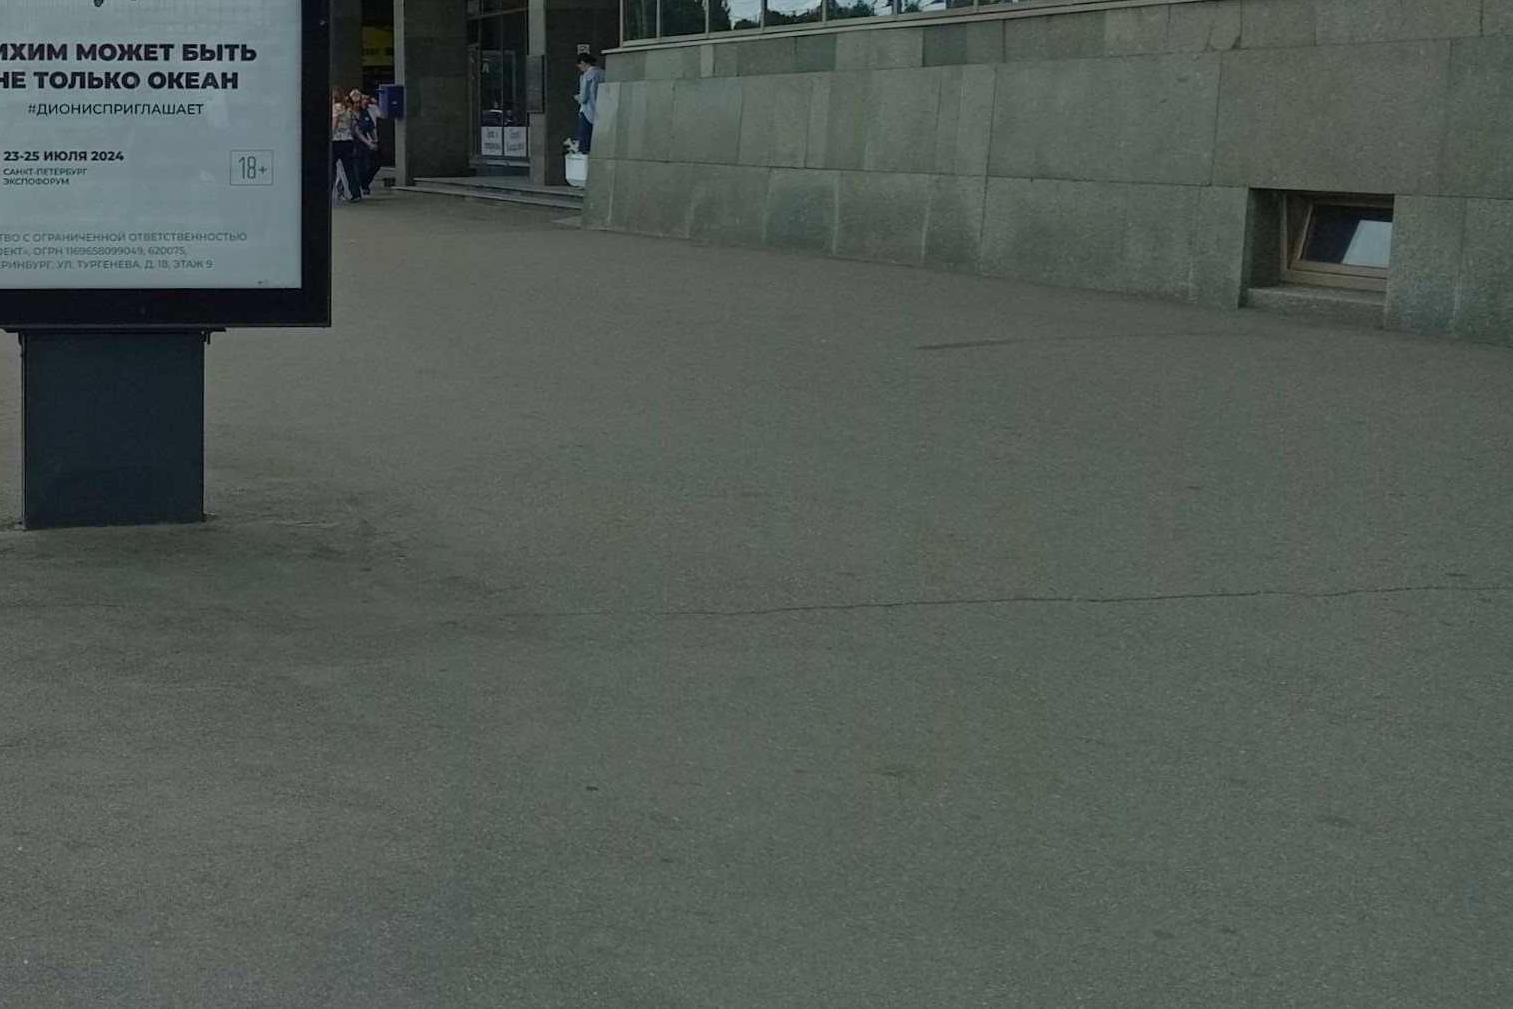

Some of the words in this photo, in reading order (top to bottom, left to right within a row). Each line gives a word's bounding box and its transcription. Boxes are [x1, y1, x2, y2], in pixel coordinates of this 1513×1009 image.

[76, 43, 174, 62] МОЖЕТ
[183, 43, 257, 62] БЫТЬ
[34, 71, 140, 90] ТОЛЬКО
[148, 71, 239, 90] ОКЕАН
[27, 103, 205, 117] #ДИОНИСПРИГЛАШАЕТ
[3, 151, 40, 161] 23-25
[44, 151, 88, 161] ИЮЛЯ
[91, 151, 125, 162] 2024
[3, 168, 89, 176] САНКТ-ПЕТЕРБУРГ
[238, 156, 268, 180] 18+
[3, 178, 70, 186] ЭКСПОФОРУМ
[23, 233, 30, 242] С
[33, 231, 127, 242] ОГРАНИЧЕННОЙ
[128, 233, 248, 242] ОТВЕТСТВЕННОСТЬЮ
[33, 246, 63, 256] ОГРН
[173, 260, 204, 270] ЭТАЖ
[205, 260, 213, 269] 9
